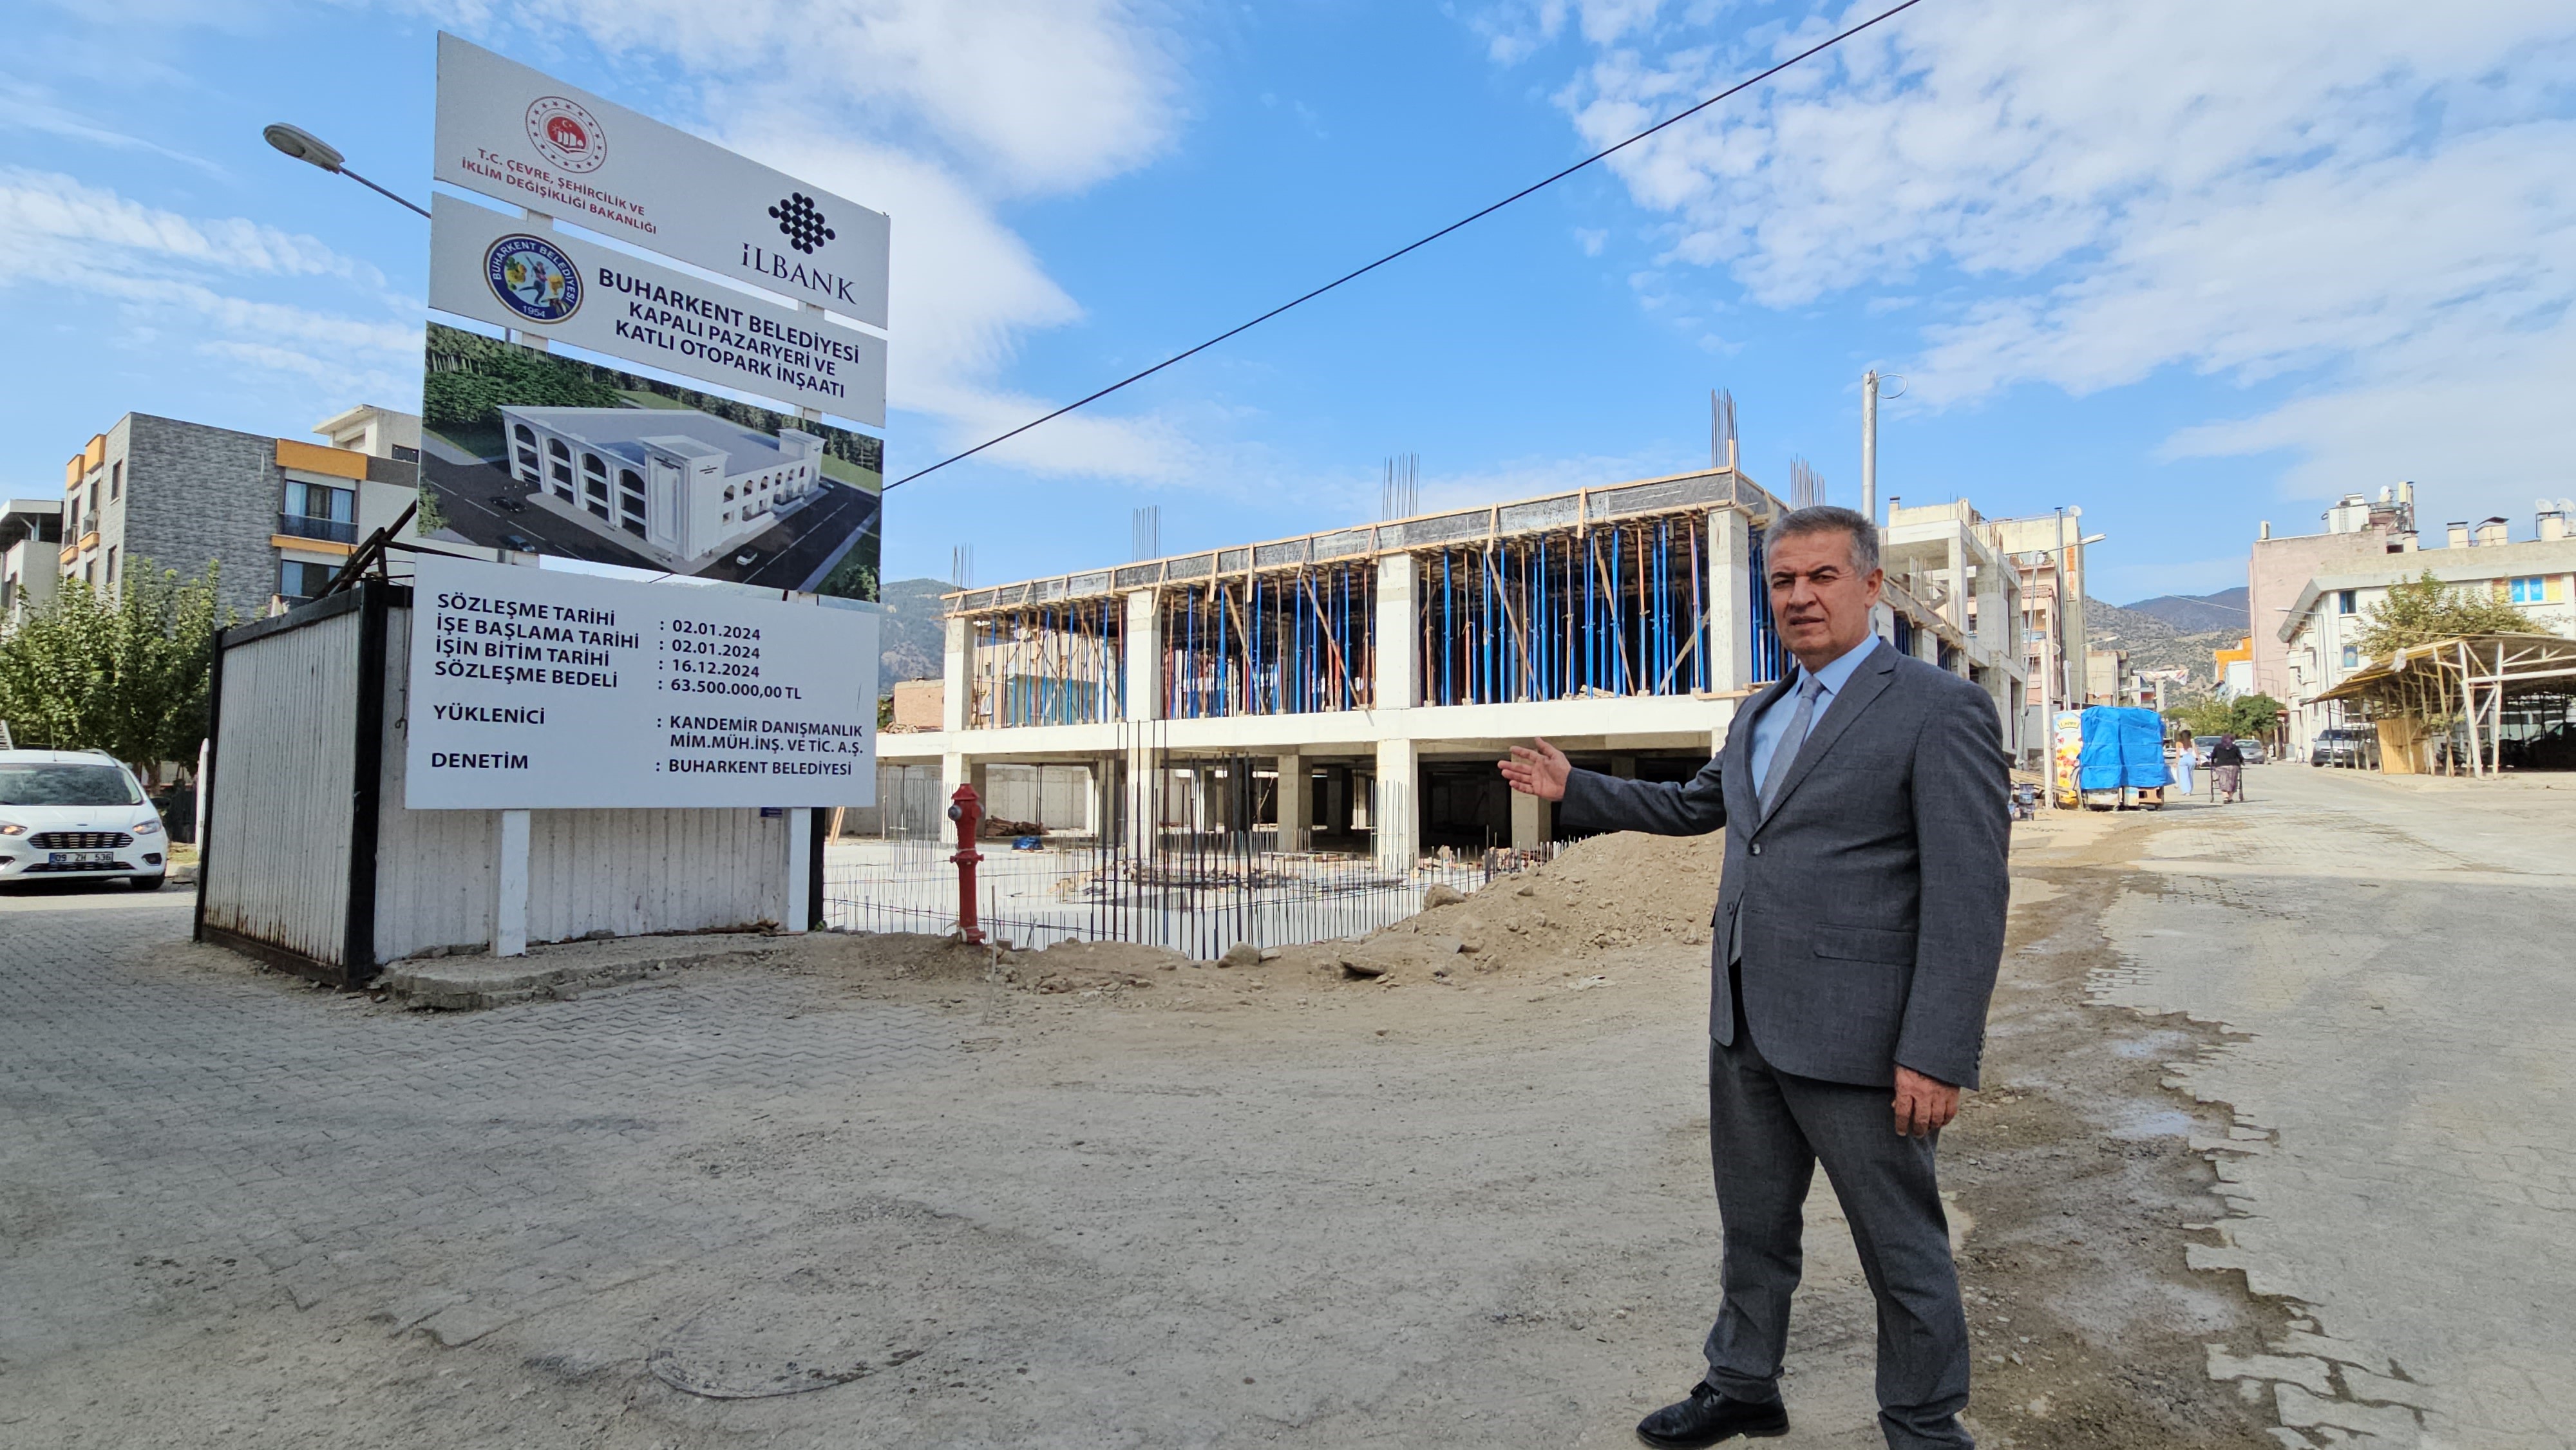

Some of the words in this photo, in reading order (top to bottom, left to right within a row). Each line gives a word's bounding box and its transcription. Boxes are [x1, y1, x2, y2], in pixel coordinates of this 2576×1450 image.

[462, 157, 501, 180] İKLİM
[507, 174, 585, 209] DEĞİŞİKLİĞİ
[590, 203, 656, 234] BAKANLIĞI
[478, 148, 502, 165] T.C.
[507, 160, 553, 184] ÇEVRE,
[558, 178, 626, 209] ŞEHİRCİLİK
[630, 203, 644, 216] VE
[493, 241, 536, 280] BUHARKENT
[523, 306, 545, 317] 1954
[600, 268, 743, 326] BUHARKENT
[750, 315, 858, 363] BELEDİYESİ
[616, 320, 674, 350] KATLI
[681, 340, 772, 377] OTOPARK
[777, 363, 844, 398] İNŞAATI
[630, 301, 702, 337] KAPALI
[710, 326, 810, 368] PAZARYERİ
[815, 357, 835, 375] VE
[437, 614, 468, 635] İŞE
[476, 620, 573, 643] BAŞLAMA
[579, 630, 638, 648] TARİHİ
[672, 639, 759, 659] 02.01.2024
[438, 592, 548, 619] SÖZLEŞME
[553, 607, 614, 626] TARİHİ
[673, 620, 760, 640] 02.01.2024
[437, 636, 477, 657] İŞİN
[486, 643, 541, 661] BİTİM
[547, 648, 609, 666] TARİHİ
[673, 659, 759, 677] 16.12.2024
[435, 659, 545, 684] SÖZLEŞME
[553, 670, 616, 687] BEDELİ
[671, 679, 782, 698] 63.500.000,00
[785, 687, 801, 699] TL
[434, 702, 544, 724] YÜKLENİCİ
[670, 716, 757, 731] KANDEMİR
[762, 720, 862, 737] DANIŞMANLIK
[432, 751, 527, 769] DENETİM
[670, 759, 768, 773] BUHARKENT
[773, 761, 851, 775] BELEDİYESİ
[788, 740, 805, 751] VE
[809, 738, 834, 752] TİC.
[838, 742, 862, 757] A.Ş.
